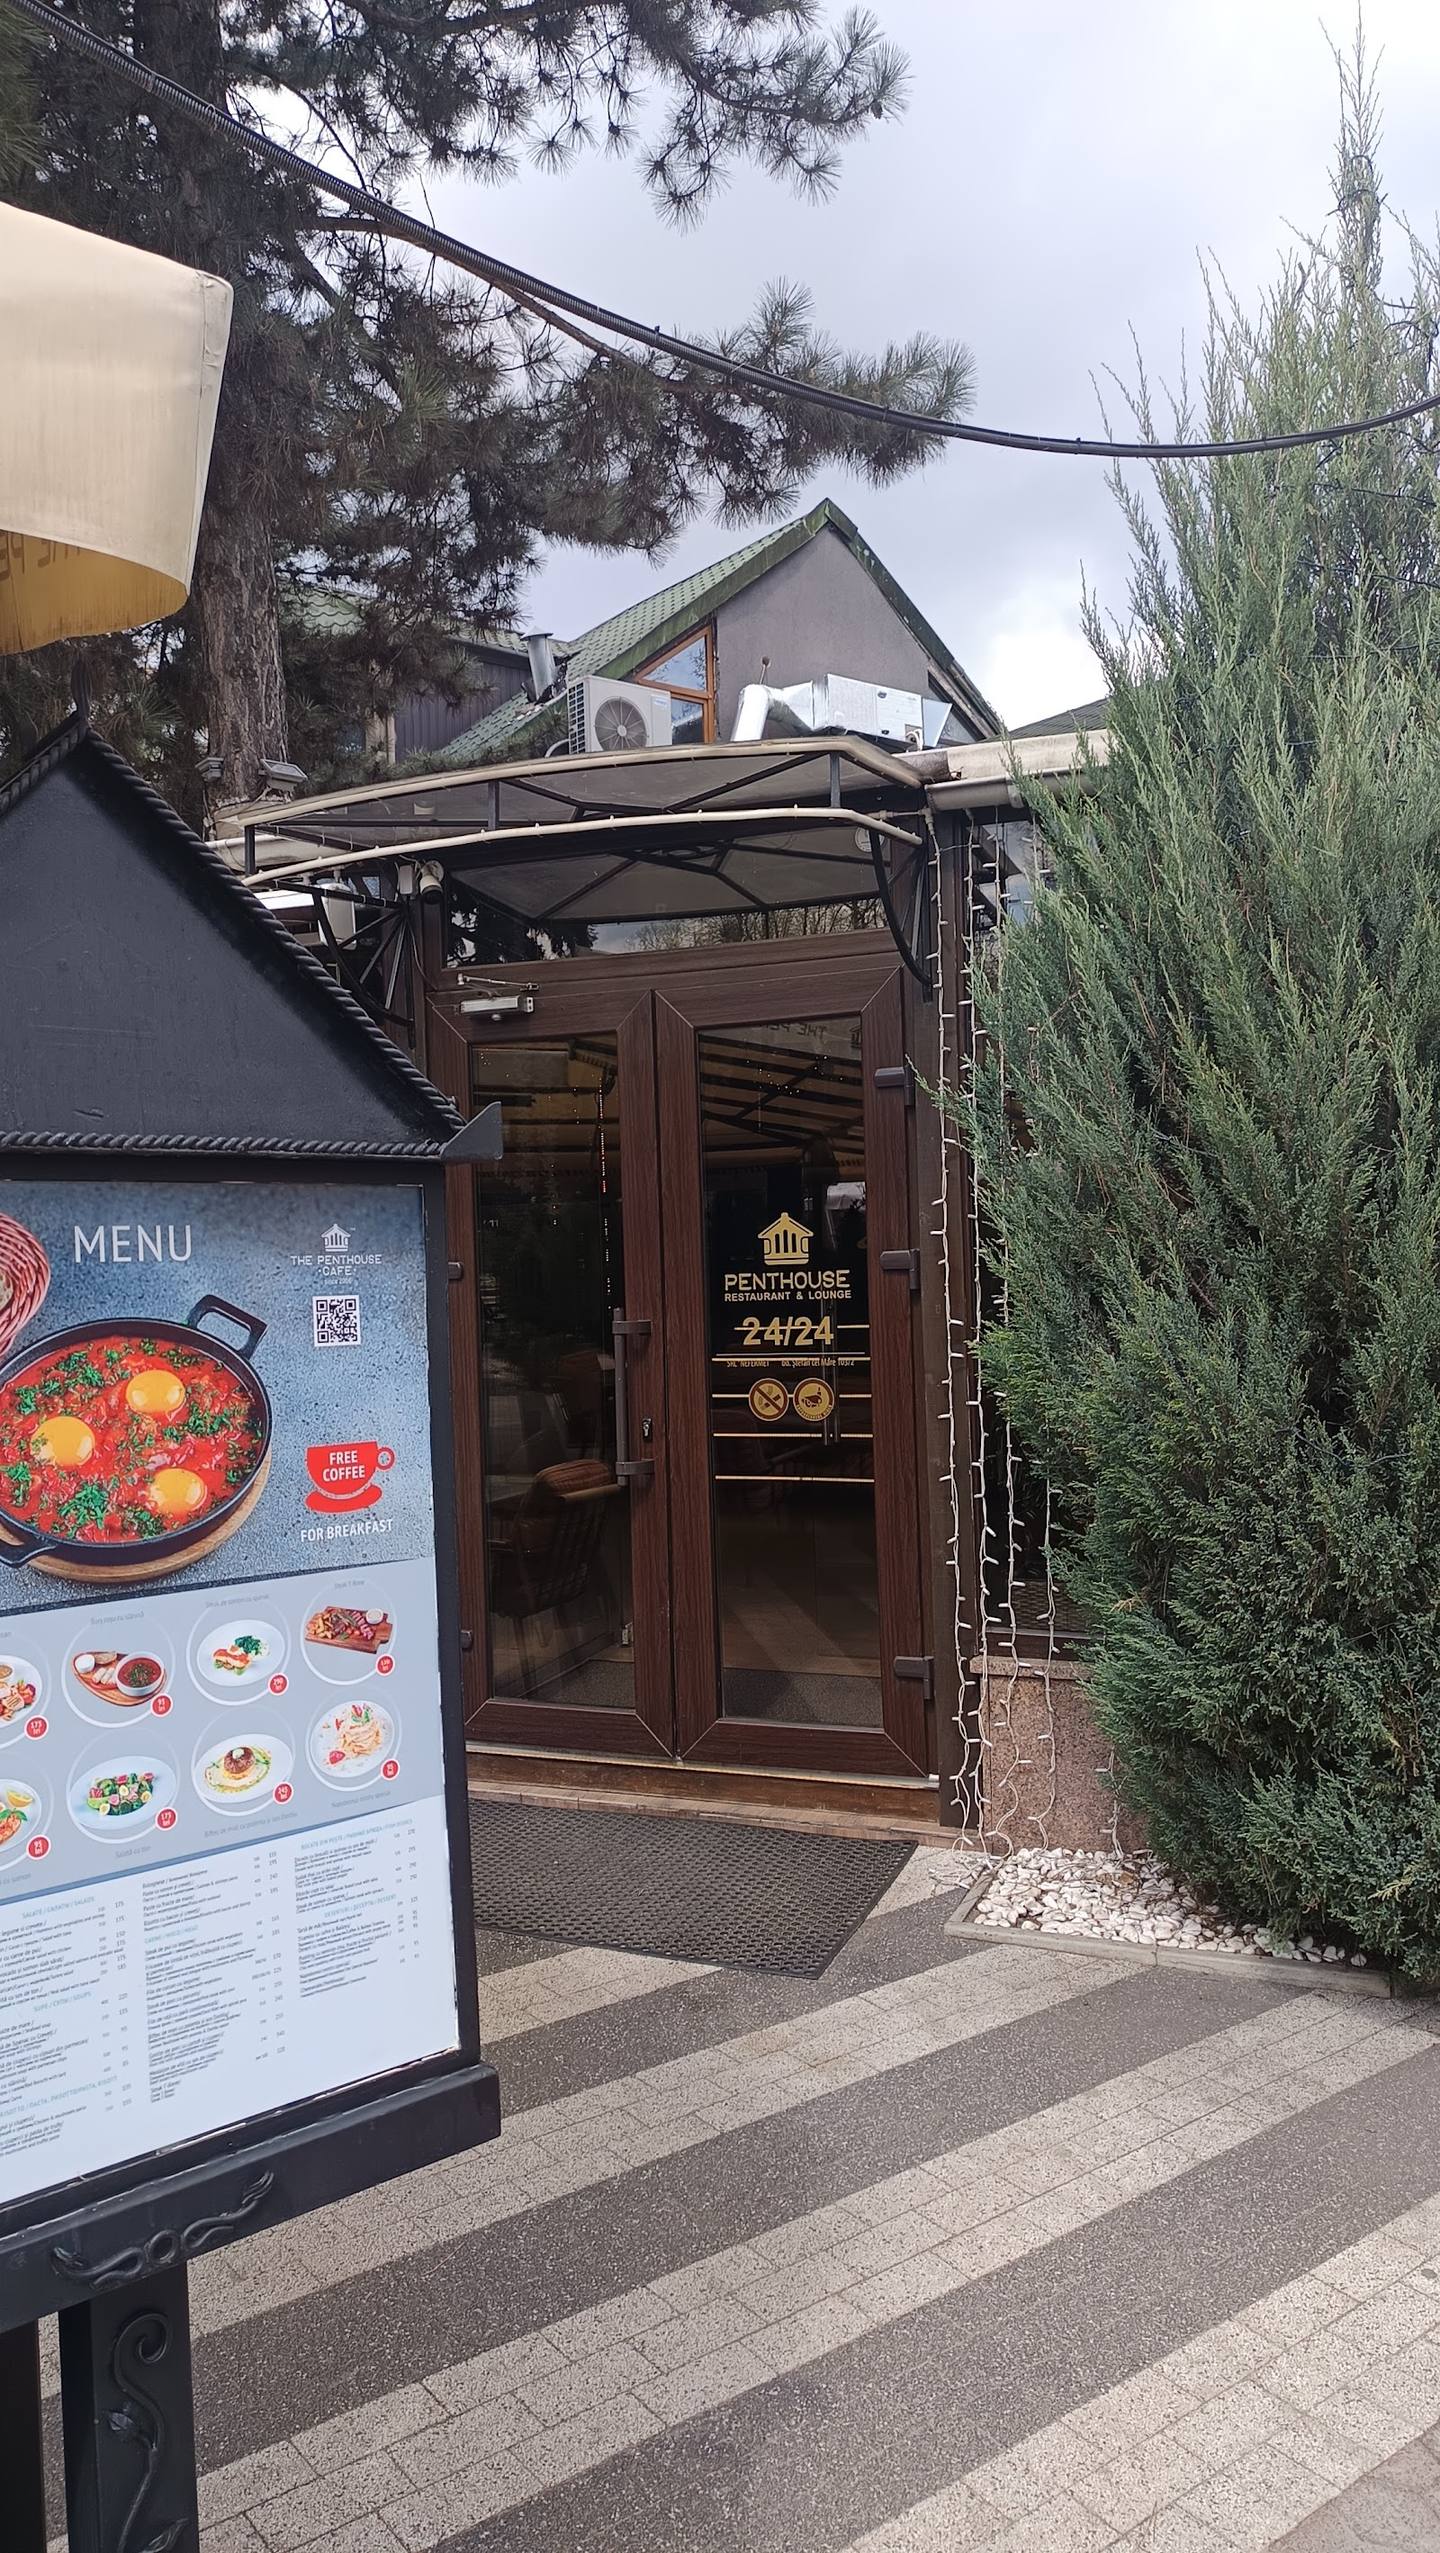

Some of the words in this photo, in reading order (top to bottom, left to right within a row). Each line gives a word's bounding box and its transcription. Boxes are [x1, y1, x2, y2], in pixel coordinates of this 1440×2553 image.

[74, 1225, 192, 1263] MENU
[290, 1255, 313, 1265] THE
[317, 1254, 382, 1265] PENTHOUSE
[724, 1269, 850, 1291] PENTHOUSE
[724, 1291, 791, 1302] RESTAURANT
[796, 1291, 804, 1301] &
[808, 1289, 852, 1300] LOUNGE
[742, 1315, 834, 1347] 24/24
[329, 1450, 358, 1465] FREE
[322, 1465, 365, 1483] COFFEE
[301, 1526, 325, 1543] FOR
[327, 1518, 394, 1540] BREAKFAST
